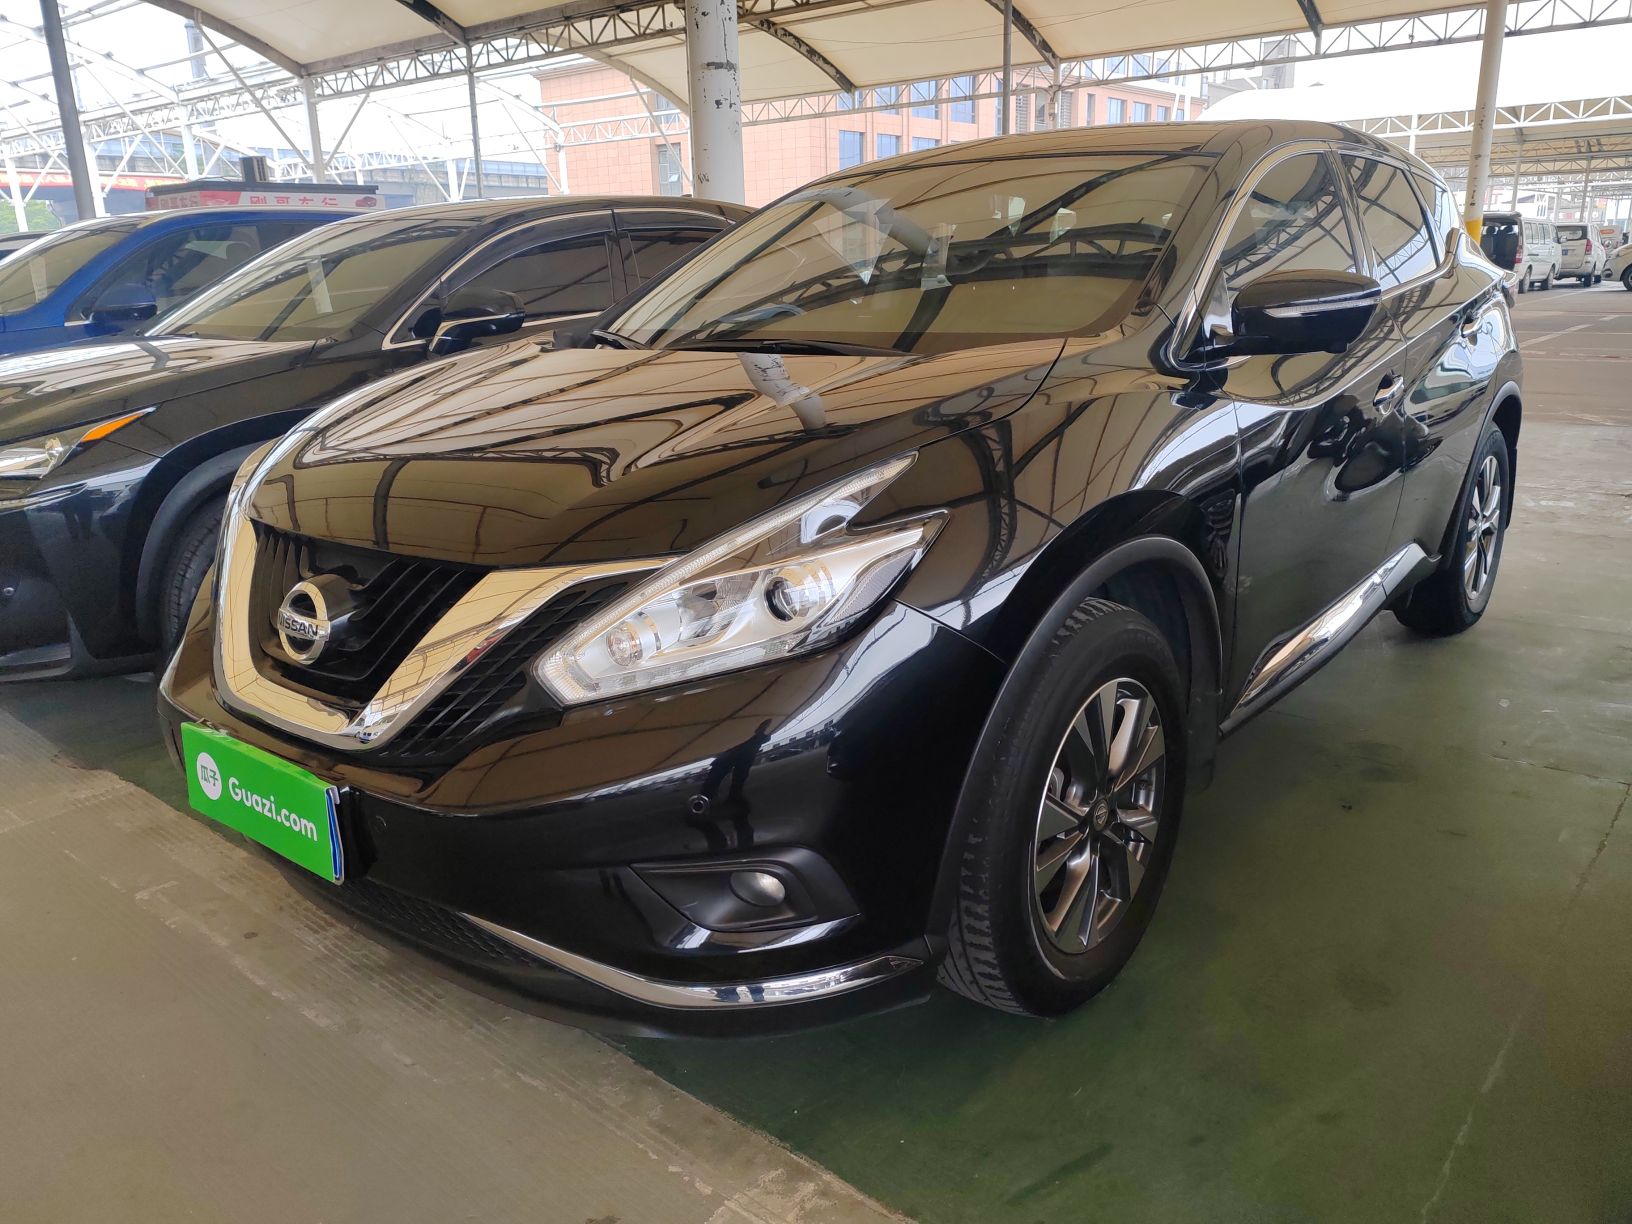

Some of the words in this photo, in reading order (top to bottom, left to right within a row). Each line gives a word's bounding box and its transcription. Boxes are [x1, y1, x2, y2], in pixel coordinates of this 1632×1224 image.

[279, 611, 318, 636] NISSAN
[200, 765, 219, 787] 瓜子
[228, 776, 318, 842] Guazi.com
